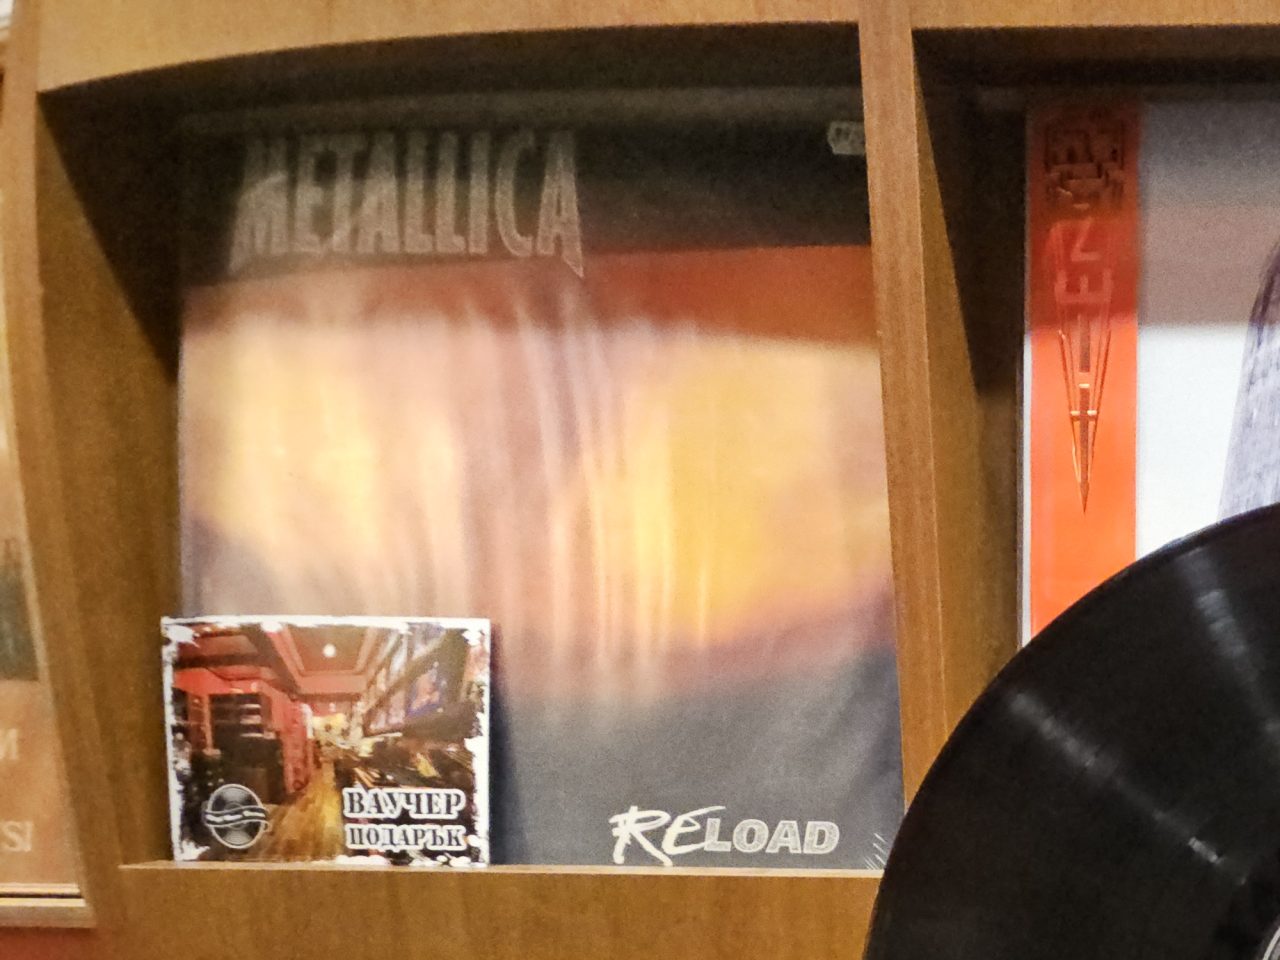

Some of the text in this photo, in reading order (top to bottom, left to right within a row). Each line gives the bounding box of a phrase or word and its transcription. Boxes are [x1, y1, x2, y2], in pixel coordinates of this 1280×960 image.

[229, 130, 584, 278] METALLICA
[348, 791, 464, 817] ВАУЧЕР
[349, 826, 464, 848] ПОДАРЪК
[608, 805, 841, 867] RELOAD
